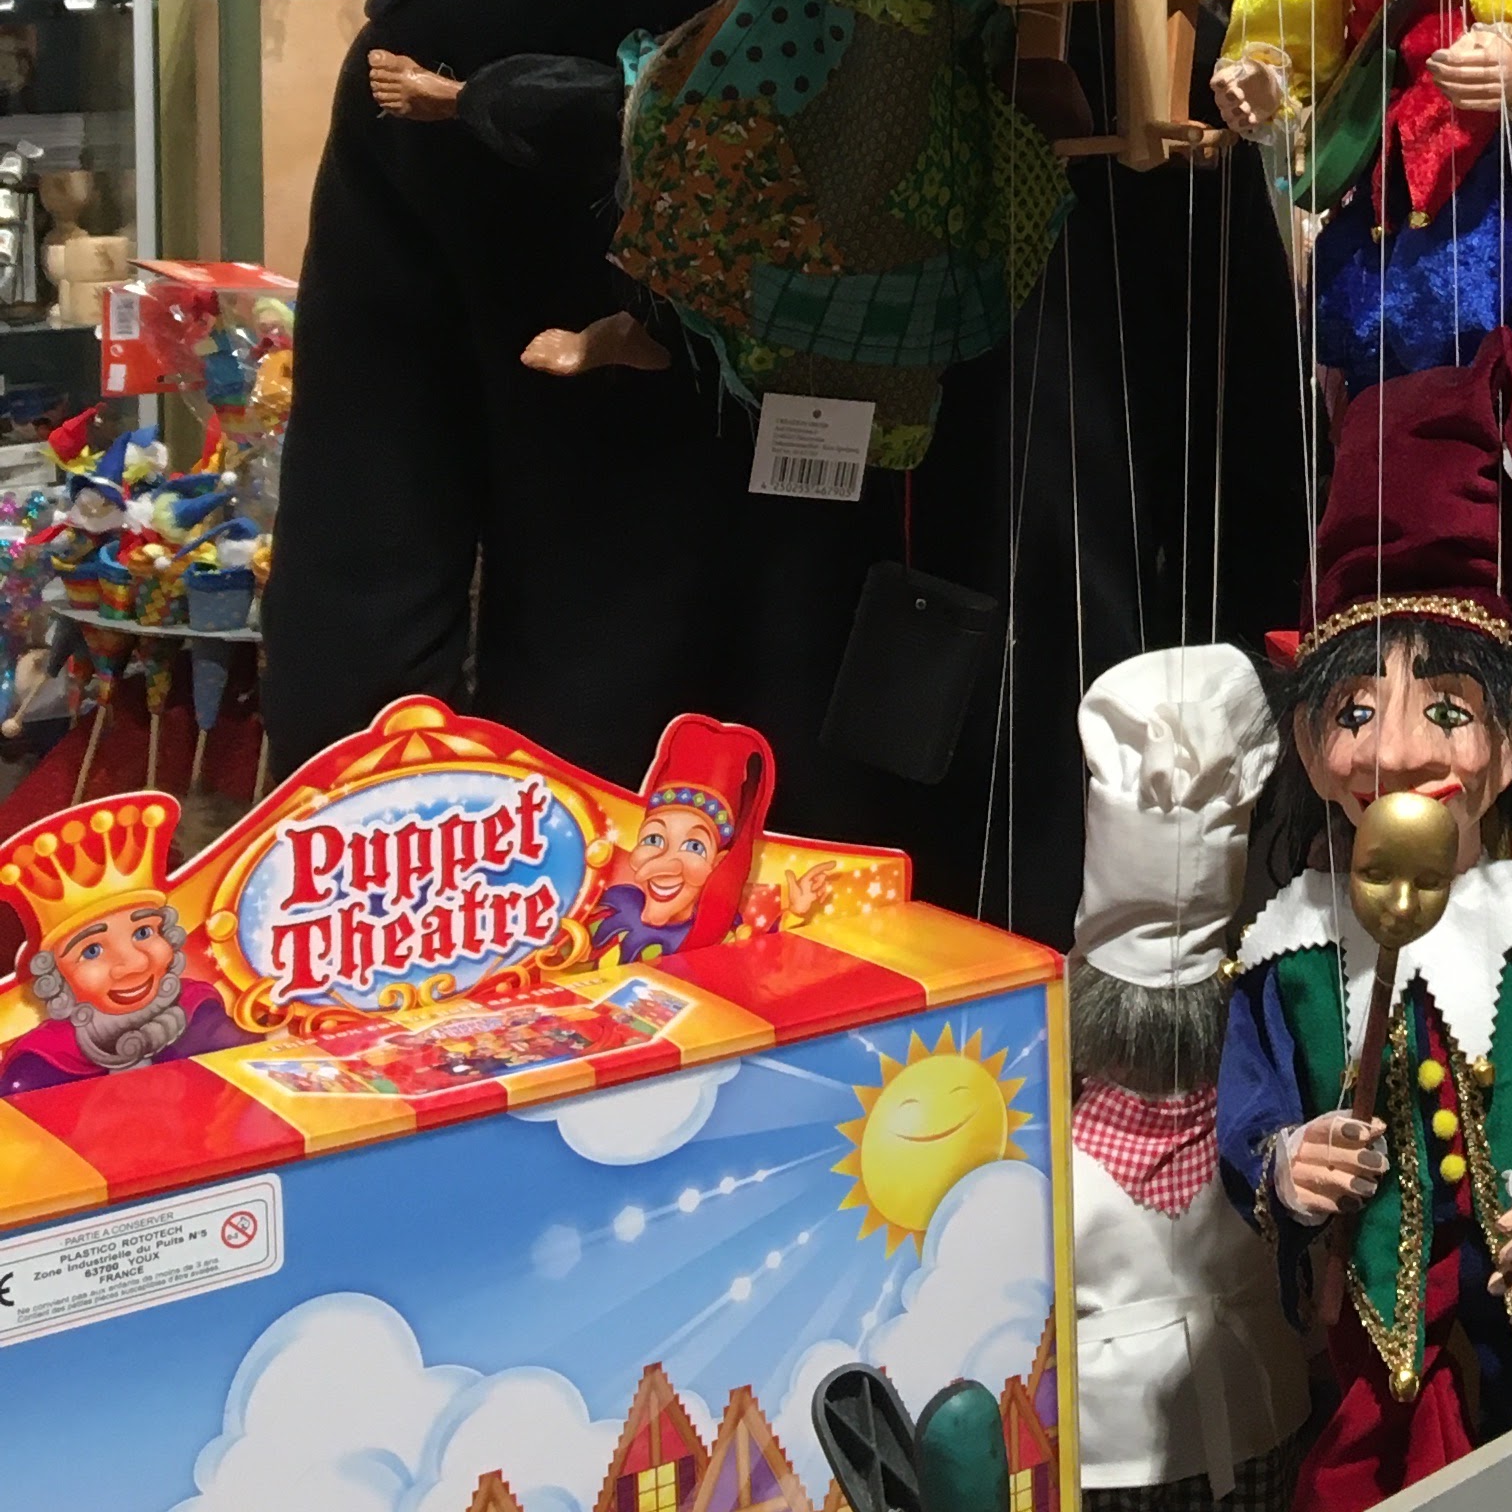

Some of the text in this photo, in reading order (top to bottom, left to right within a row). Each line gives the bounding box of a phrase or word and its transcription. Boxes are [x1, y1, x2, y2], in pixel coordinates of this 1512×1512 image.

[280, 782, 548, 910] Puppet
[271, 880, 555, 998] Theatre
[60, 1225, 183, 1263] PLASTICO ROTOTECH
[65, 1212, 174, 1246] PARTIE A CONSERVER
[33, 1268, 62, 1281] Zone
[67, 1250, 131, 1272] Industrielle
[136, 1244, 151, 1254] du
[156, 1236, 184, 1249] Puits
[84, 1251, 160, 1278] 63700 YOUX
[99, 1265, 144, 1284] FRANCE
